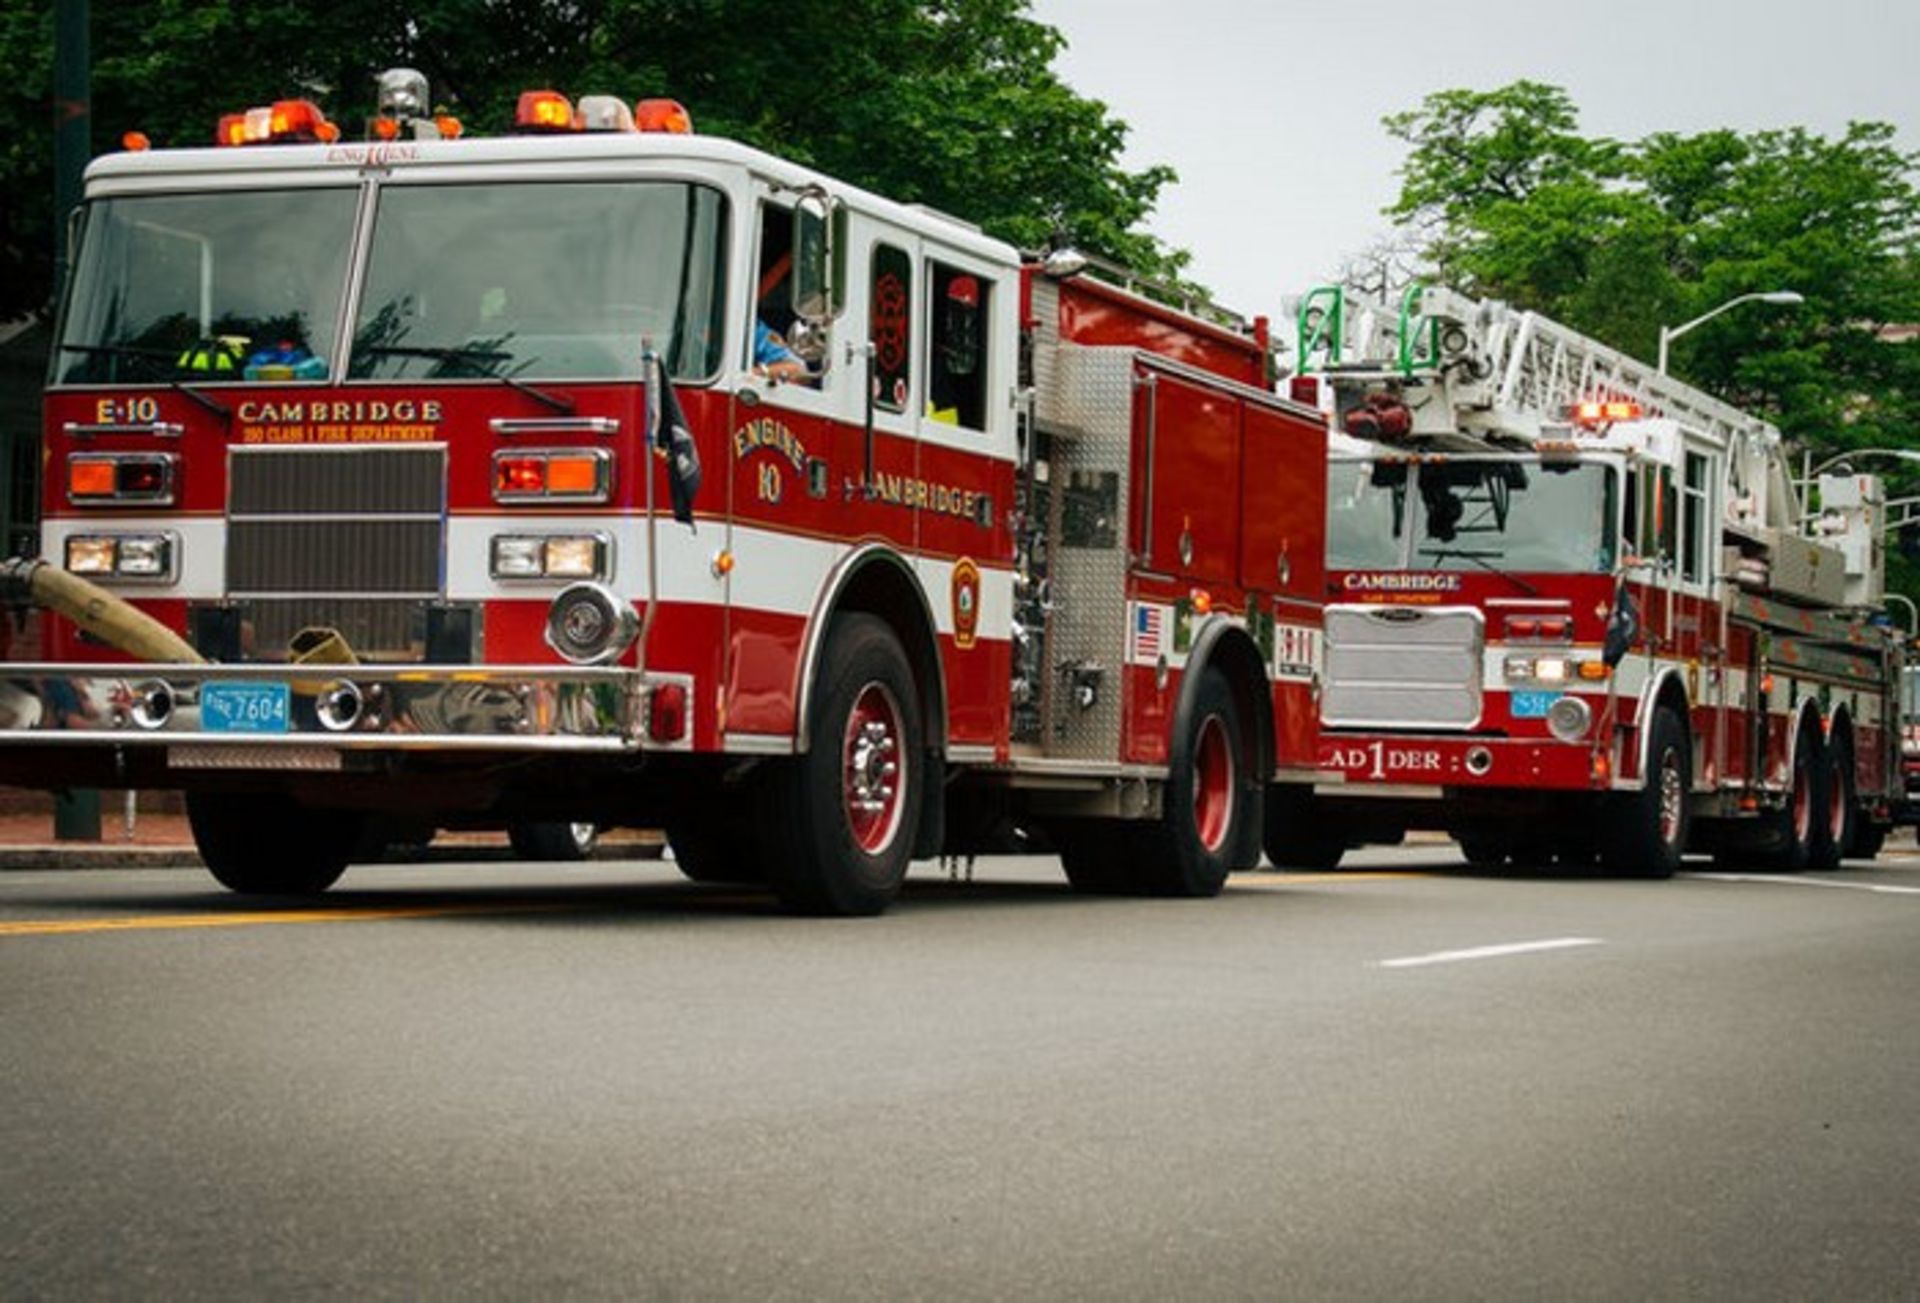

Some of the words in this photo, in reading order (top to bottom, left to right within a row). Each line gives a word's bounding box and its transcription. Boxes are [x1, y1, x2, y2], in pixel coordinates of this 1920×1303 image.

[237, 401, 442, 424] CAMBRIDGE
[317, 425, 348, 440] FIRE
[352, 425, 436, 440] DEPARTMENT
[734, 417, 807, 475] ENGINE
[758, 462, 781, 503] 10
[1343, 573, 1461, 591] CAMBRIDGE
[235, 695, 284, 722] 7604
